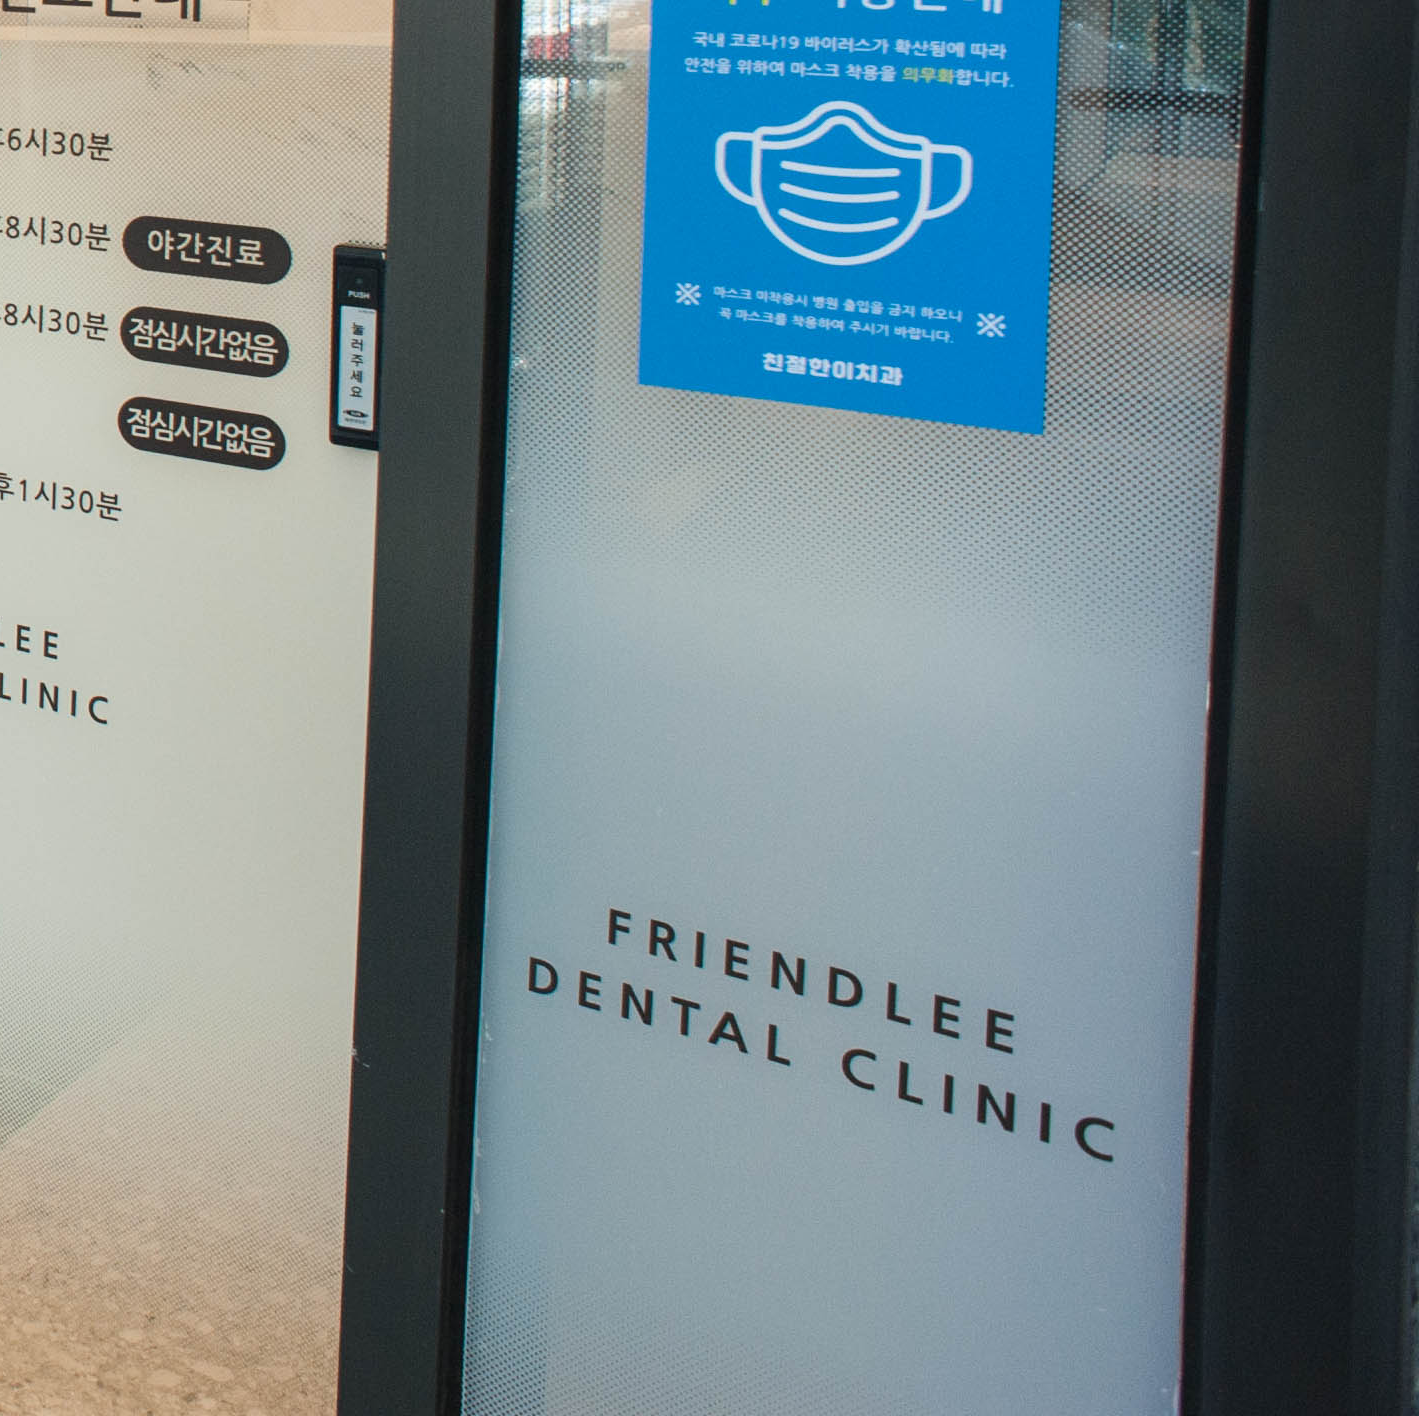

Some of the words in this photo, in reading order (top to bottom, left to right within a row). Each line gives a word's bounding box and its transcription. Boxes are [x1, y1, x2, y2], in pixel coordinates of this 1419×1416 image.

[692, 31, 725, 48] 국내
[729, 33, 800, 50] 코로나19
[804, 36, 890, 55] 바이러스가
[970, 42, 1007, 60] 따라
[684, 57, 731, 74] 안전을
[737, 59, 785, 77] 위하여
[790, 62, 839, 77] 마스크
[845, 63, 896, 82] 착용을
[147, 228, 266, 268] 야간진료
[128, 318, 279, 367] 점심시간없음
[849, 320, 890, 336] 주시기
[762, 351, 904, 386] 친절한이치과
[126, 406, 276, 459] 점심시간없음
[607, 907, 1015, 1054] FRIENDLEE
[527, 955, 791, 1067] DENTAL
[841, 1047, 1116, 1163] CLINIC
